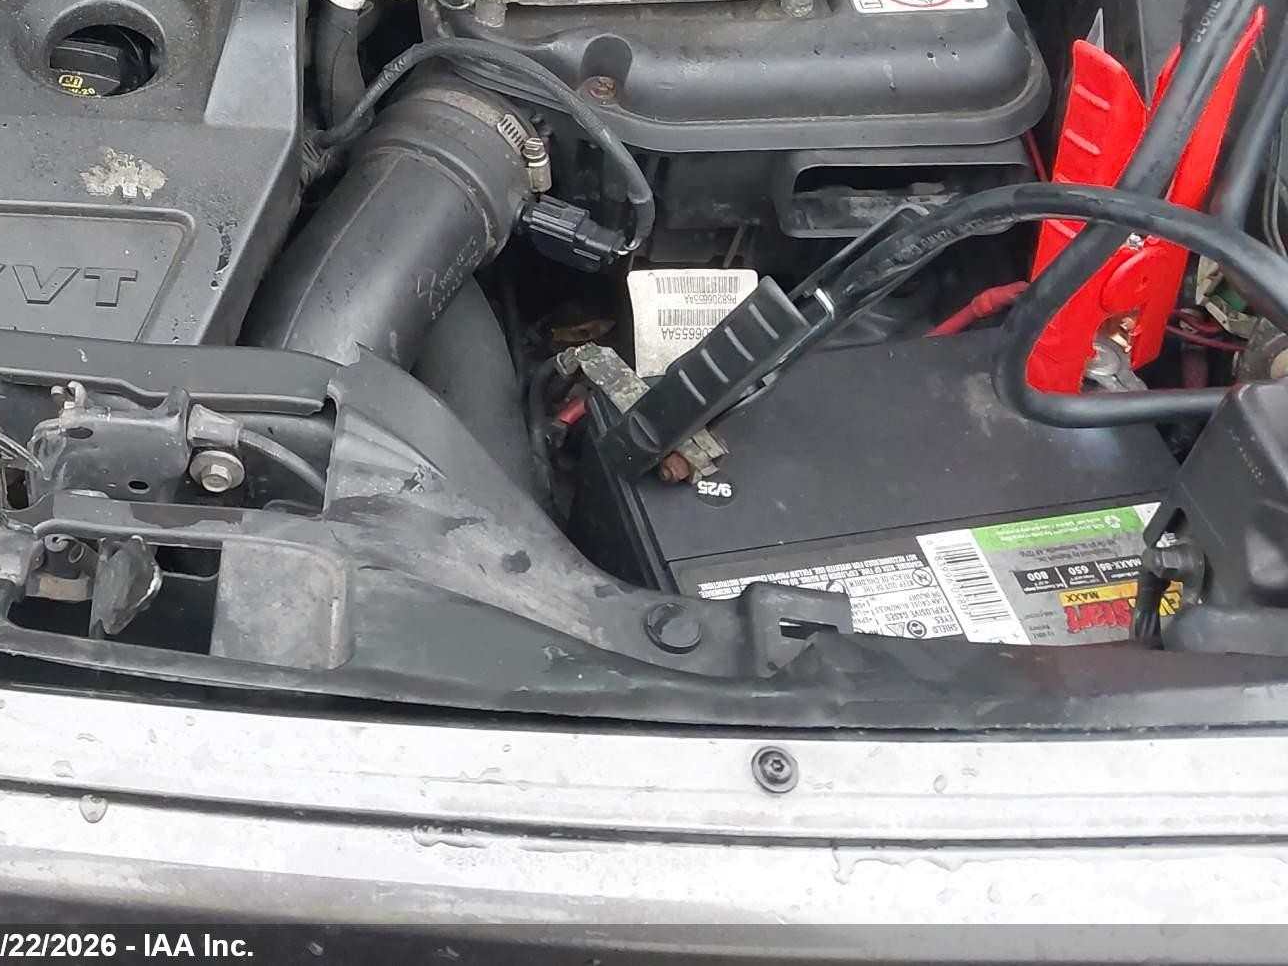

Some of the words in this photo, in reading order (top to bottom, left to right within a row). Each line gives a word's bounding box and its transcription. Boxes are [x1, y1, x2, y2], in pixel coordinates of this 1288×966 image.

[684, 294, 737, 304] P68206655AA
[697, 480, 732, 498] 9/25
[1026, 570, 1049, 581] 800
[1067, 564, 1089, 576] 650
[1064, 591, 1100, 603] MAXX
[885, 610, 909, 621] GASES
[911, 605, 950, 618] EXPLOSIVE
[934, 614, 953, 624] EYES
[931, 623, 959, 634] SHIELD
